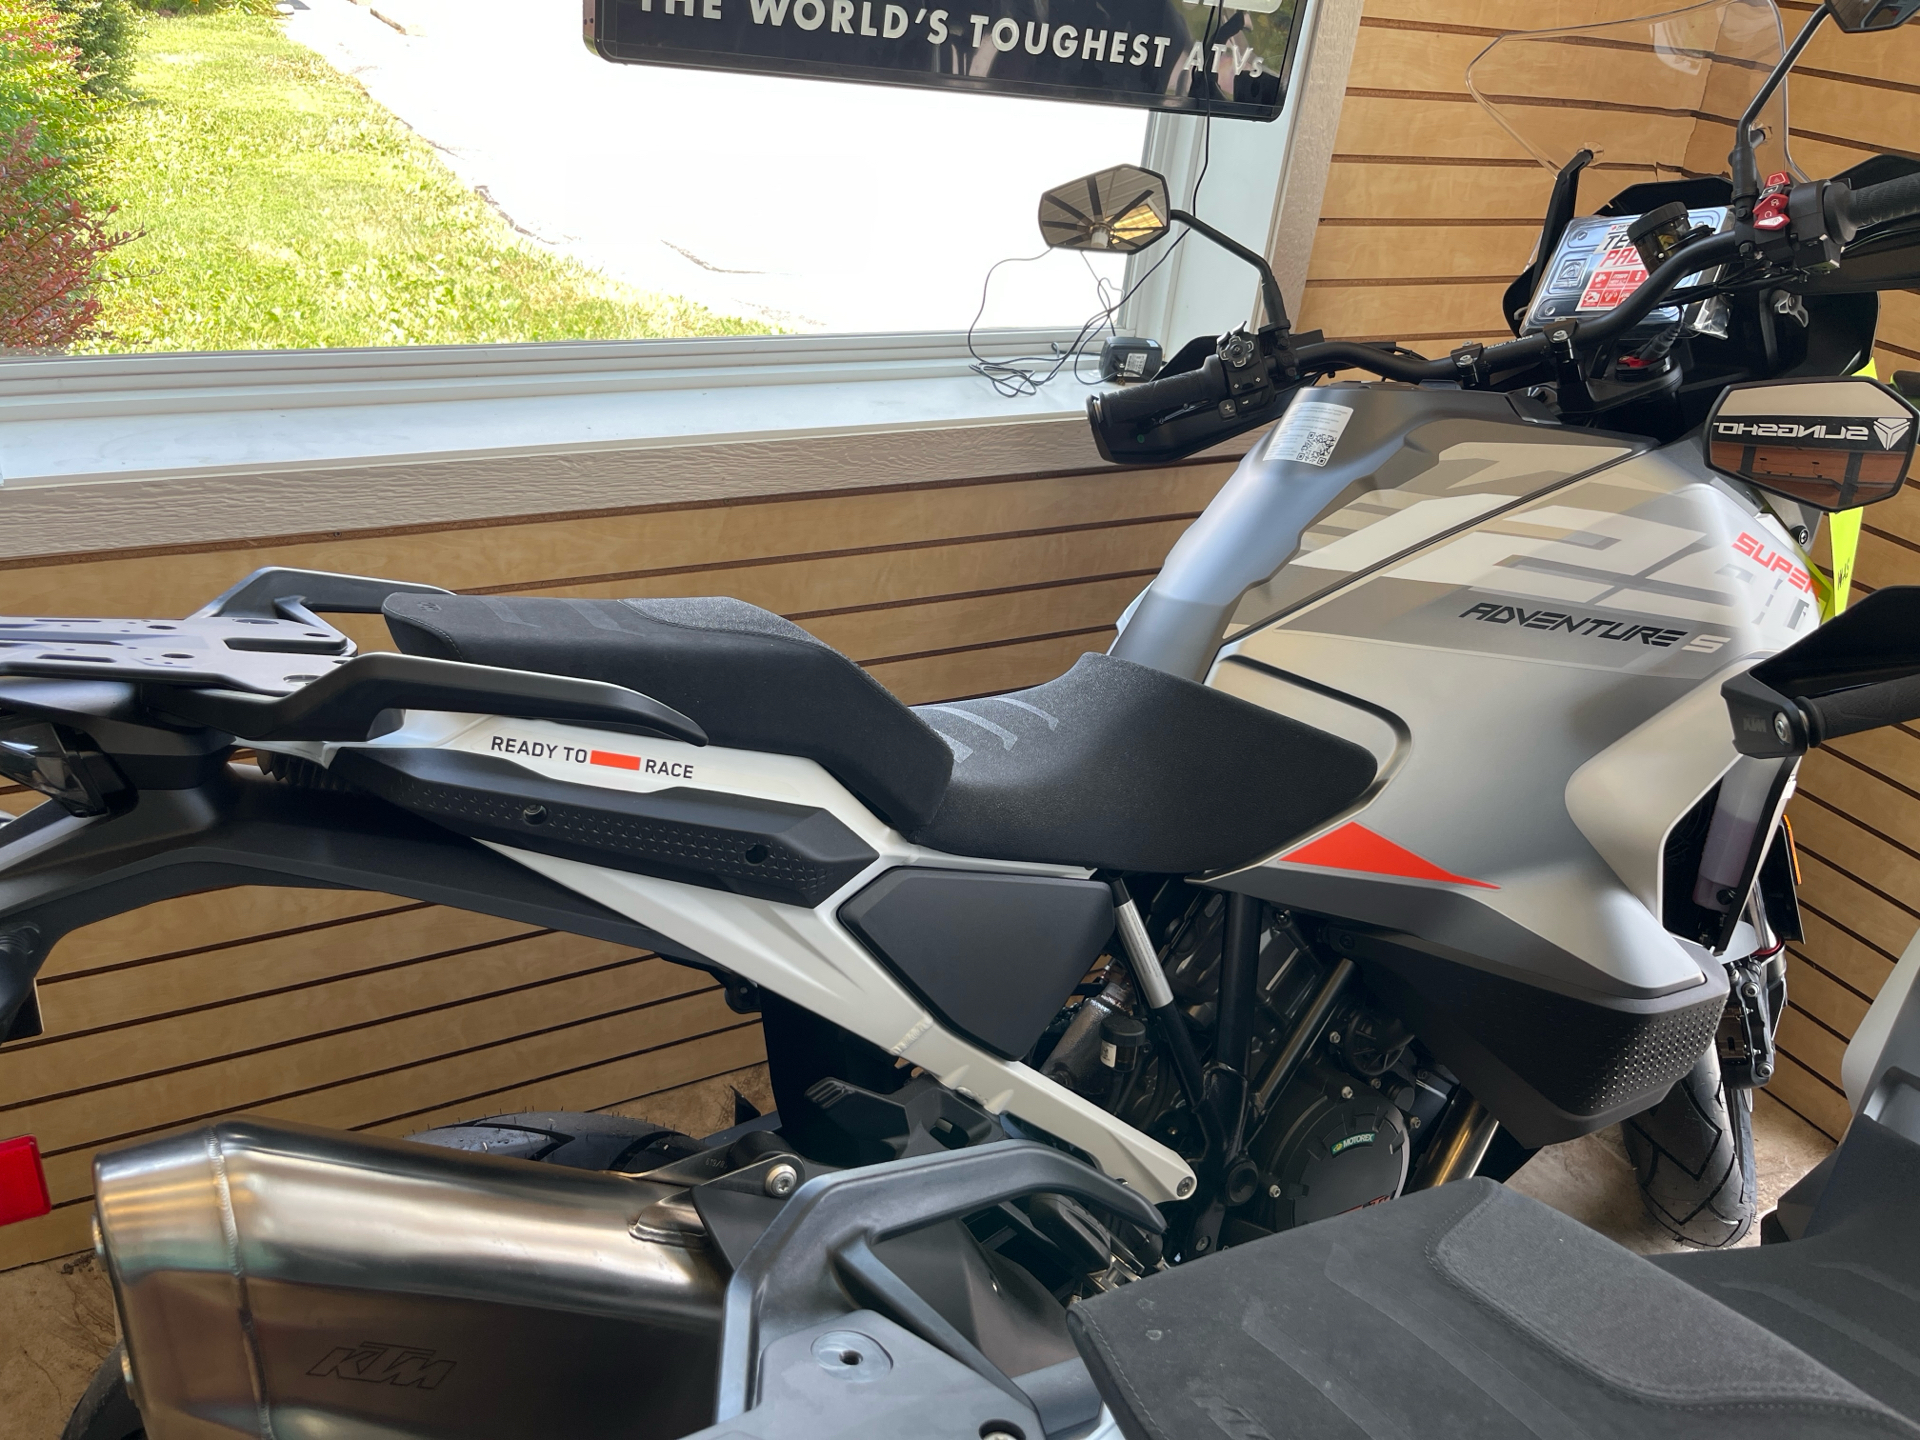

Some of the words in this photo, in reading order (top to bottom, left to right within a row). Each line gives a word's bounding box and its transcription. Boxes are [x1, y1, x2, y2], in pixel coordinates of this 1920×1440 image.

[750, 0, 949, 45] WORLD'S
[970, 14, 1171, 68] TOUGHEST
[1458, 602, 1688, 648] ADVENTURE
[1681, 634, 1732, 654] S
[490, 735, 559, 759] READY
[563, 746, 588, 764] TO
[644, 758, 694, 779] RACE
[1343, 1133, 1375, 1148] MOTOREX
[305, 1340, 457, 1390] KTM
